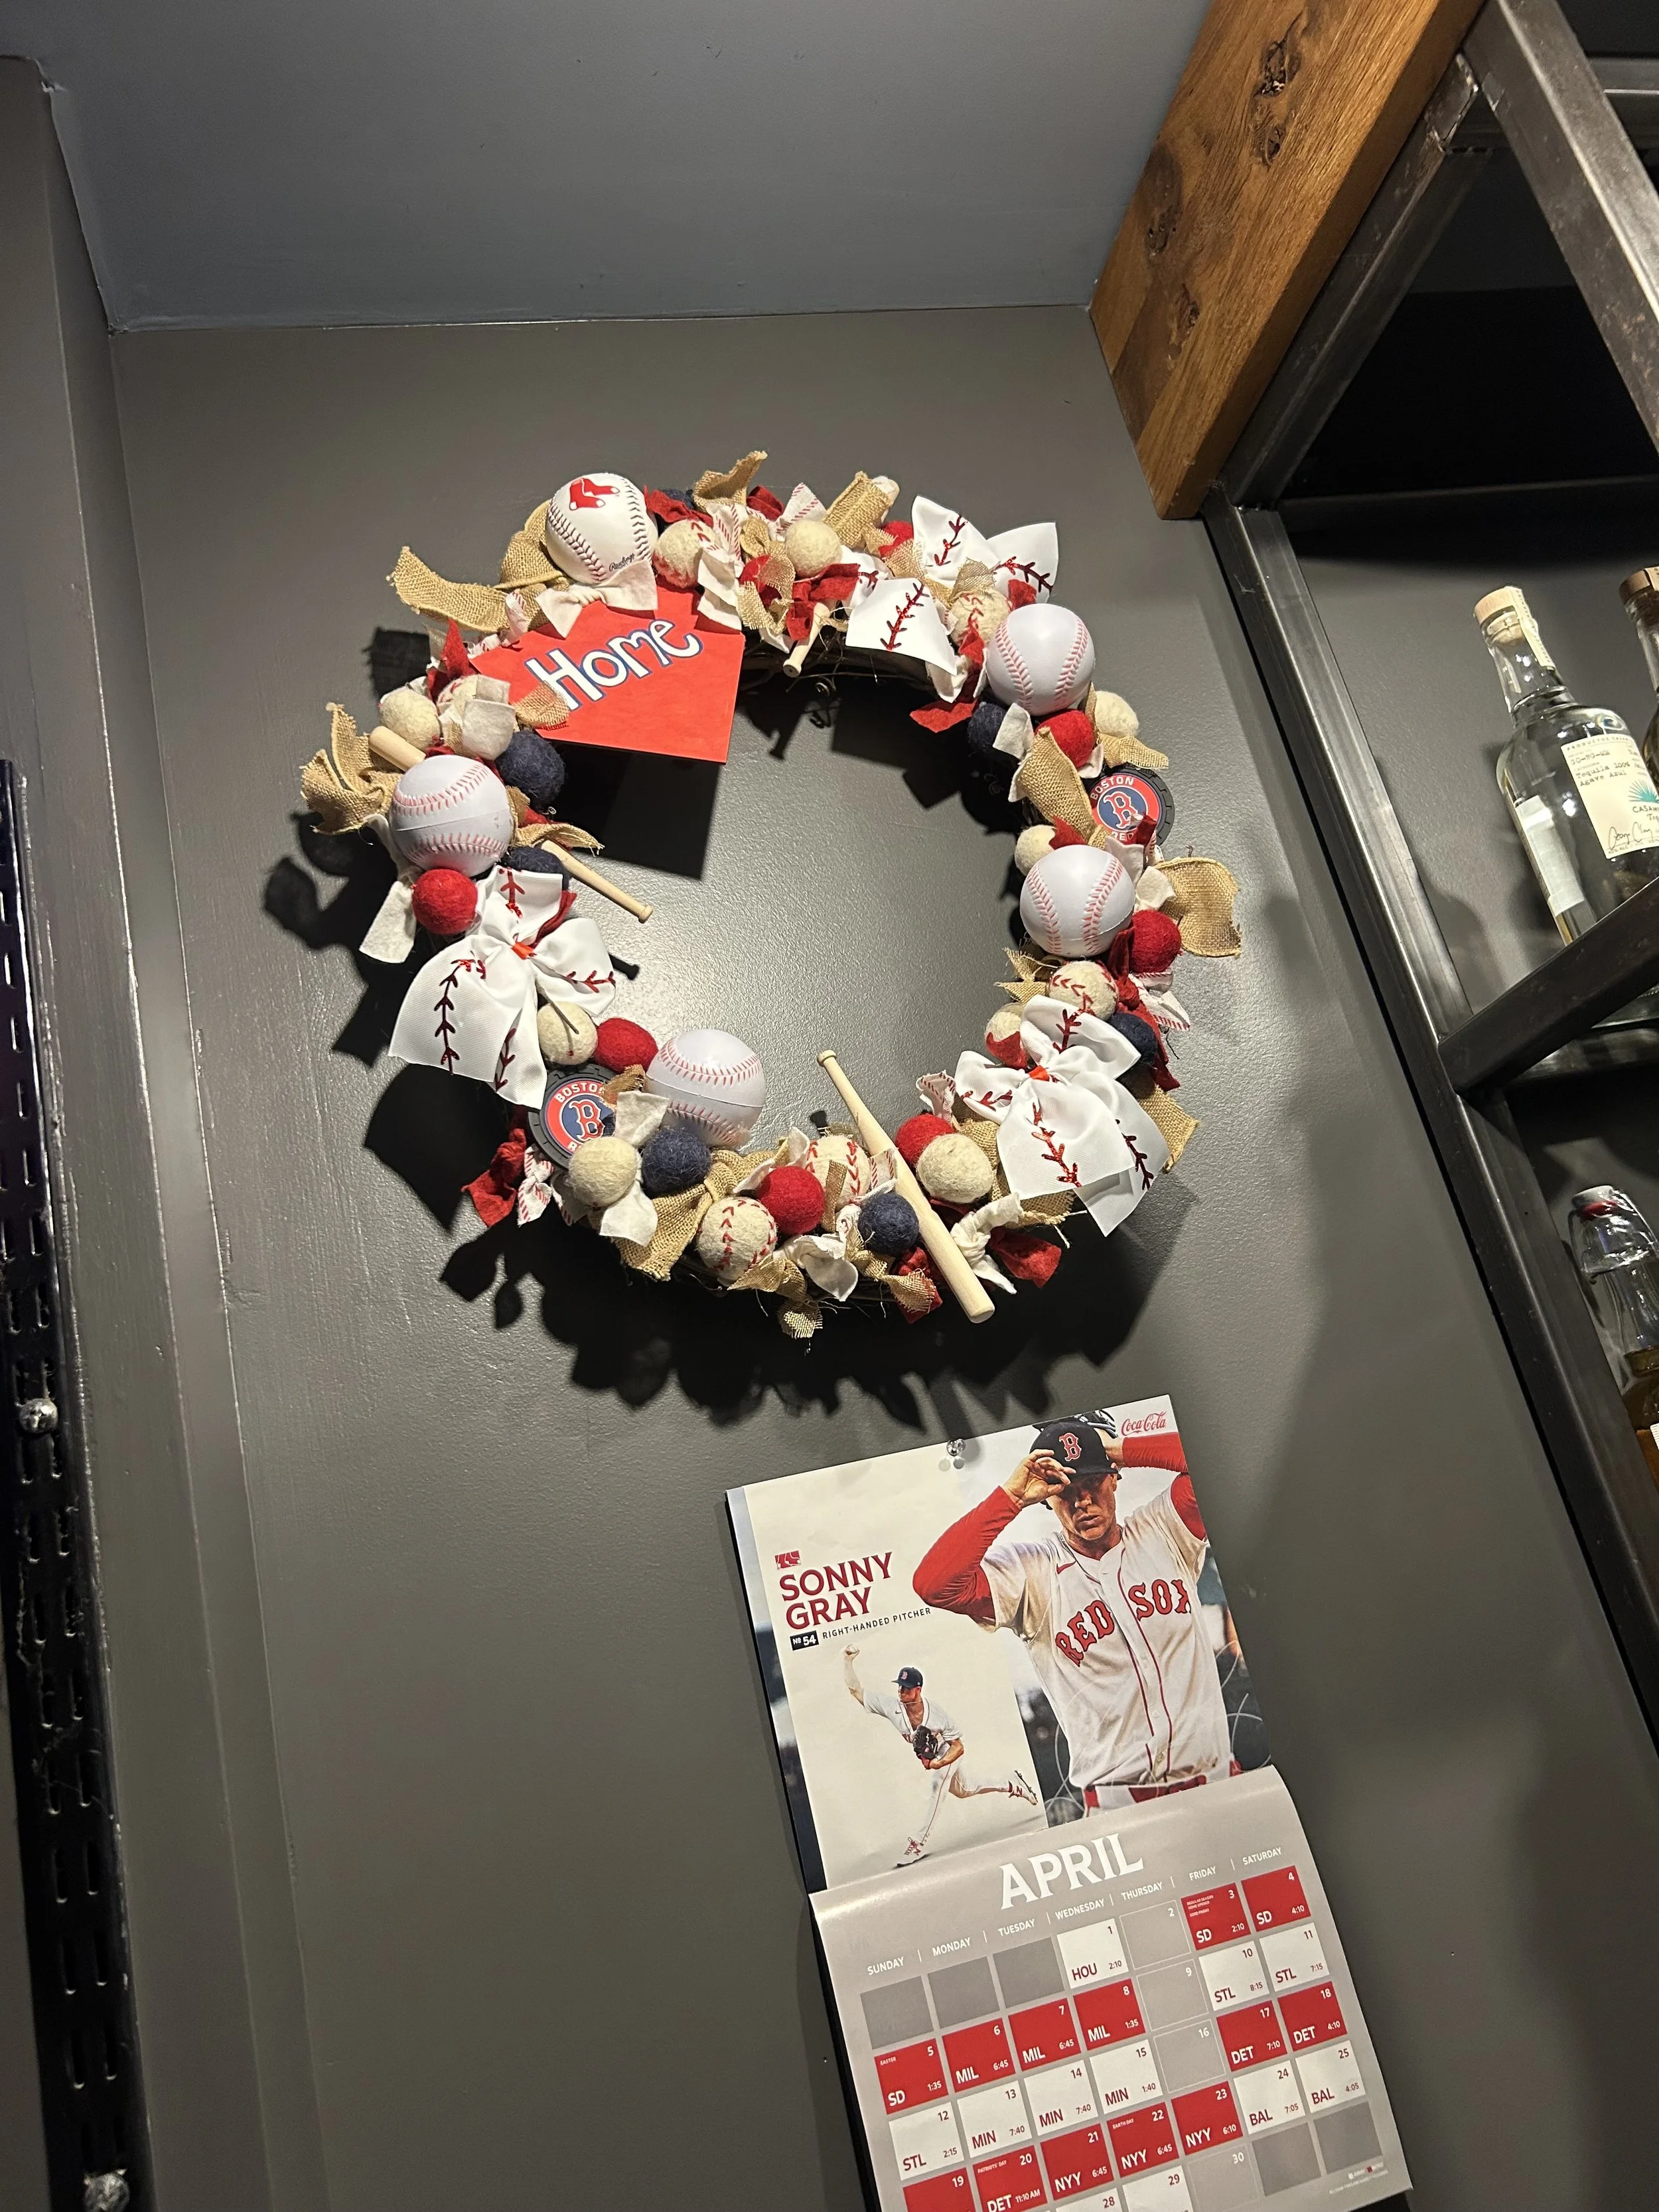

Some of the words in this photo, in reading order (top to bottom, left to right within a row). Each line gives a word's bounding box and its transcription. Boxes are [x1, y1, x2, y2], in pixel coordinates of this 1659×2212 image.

[525, 619, 703, 711] Home
[1575, 765, 1610, 778] Tequila
[1580, 775, 1604, 786] Agave
[1090, 776, 1134, 800] BOSTON
[1103, 791, 1139, 829] B
[569, 1099, 606, 1142] B
[1058, 1432, 1082, 1461] B
[779, 1551, 893, 1601] SONNY
[786, 1586, 872, 1630] GRAY
[822, 1617, 890, 1639] RIGHT-HANDED
[893, 1607, 931, 1623] PITCHER
[1054, 1599, 1115, 1667] RED
[802, 1635, 817, 1646] 54
[998, 1832, 1144, 1910] APRIL
[1288, 1872, 1295, 1881] 4
[1228, 1889, 1234, 1899] 3
[867, 1956, 905, 1976] SUNDAY
[932, 1937, 972, 1956] MONDAY
[997, 1919, 1035, 1937] TUESDAY
[1054, 1898, 1106, 1920] WEDNESDAY
[1121, 1881, 1163, 1901] THURSDAY
[1189, 1866, 1217, 1881] FRIDAY
[1242, 1846, 1283, 1866] SATURDAY
[1167, 1907, 1175, 1917] 2
[1256, 1910, 1272, 1925] SD
[1291, 1905, 1305, 1915] 4:10
[1108, 1925, 1113, 1935] 1
[1196, 1929, 1212, 1943] SD
[1232, 1923, 1244, 1933] 2:10
[1303, 1930, 1313, 1940] 11
[1242, 1948, 1253, 1958] 10
[1072, 1962, 1098, 1981] HOU
[1108, 1960, 1122, 1970] 2:10
[1185, 1967, 1192, 1977] 9
[1275, 1968, 1297, 1983] STL
[1311, 1963, 1323, 1972] 7:15
[1123, 1985, 1130, 1996] 8
[1214, 1987, 1236, 2003] STL
[1250, 1982, 1263, 1992] 8:15
[1321, 1988, 1331, 1999] 18
[1058, 2004, 1065, 2015] 7
[1260, 2008, 1270, 2018] 17
[993, 2026, 1001, 2035] 6
[1087, 2025, 1111, 2042] MIL
[1124, 2018, 1139, 2029] 1:35
[1198, 2028, 1210, 2038] 16
[1293, 2026, 1316, 2044] DET
[1327, 2021, 1340, 2031] 4:10
[927, 2045, 934, 2056] 5
[1022, 2046, 1046, 2064] MIL
[1058, 2039, 1074, 2050] 6:45
[1135, 2047, 1147, 2058] 15
[1230, 2046, 1254, 2064] DET
[1267, 2040, 1281, 2050] 7:10
[1338, 2048, 1350, 2059] 25
[956, 2066, 979, 2084] MIL
[993, 2059, 1009, 2071] 6:45
[1070, 2067, 1082, 2079] 14
[1277, 2068, 1289, 2080] 24
[887, 2090, 906, 2106] SD
[927, 2081, 942, 2091] 1:35
[1005, 2089, 1017, 2101] 13
[1105, 2087, 1129, 2106] MIN
[1141, 2083, 1156, 2093] 1:40
[1215, 2088, 1228, 2101] 23
[1311, 2087, 1335, 2105] BAL
[1345, 2083, 1360, 2093] 4:05
[938, 2110, 949, 2122] 12
[1039, 2108, 1064, 2128] MIN
[1076, 2104, 1091, 2115] 7:40
[1151, 2109, 1165, 2122] 22
[1249, 2108, 1273, 2126] BAL
[1284, 2103, 1299, 2114] 7:05
[972, 2130, 997, 2150] MIN
[1009, 2125, 1025, 2136] 7:40
[1088, 2130, 1099, 2144] 21
[1185, 2127, 1211, 2148] NYY
[1222, 2124, 1237, 2135] 6:10
[902, 2154, 926, 2172] STL
[943, 2147, 958, 2158] 2:15
[1019, 2153, 1033, 2166] 20
[1121, 2149, 1147, 2170] NYY
[1157, 2144, 1173, 2155] 6:45
[1232, 2152, 1244, 2164] 30
[952, 2175, 964, 2188] 19
[1054, 2172, 1082, 2192] NYY
[1092, 2166, 1108, 2177] 6:45
[1168, 2174, 1180, 2185] 29
[987, 2194, 1012, 2212] DET
[1015, 2193, 1029, 2204] 11:10
[1029, 2189, 1041, 2200] AM
[1102, 2196, 1115, 2209] 28
